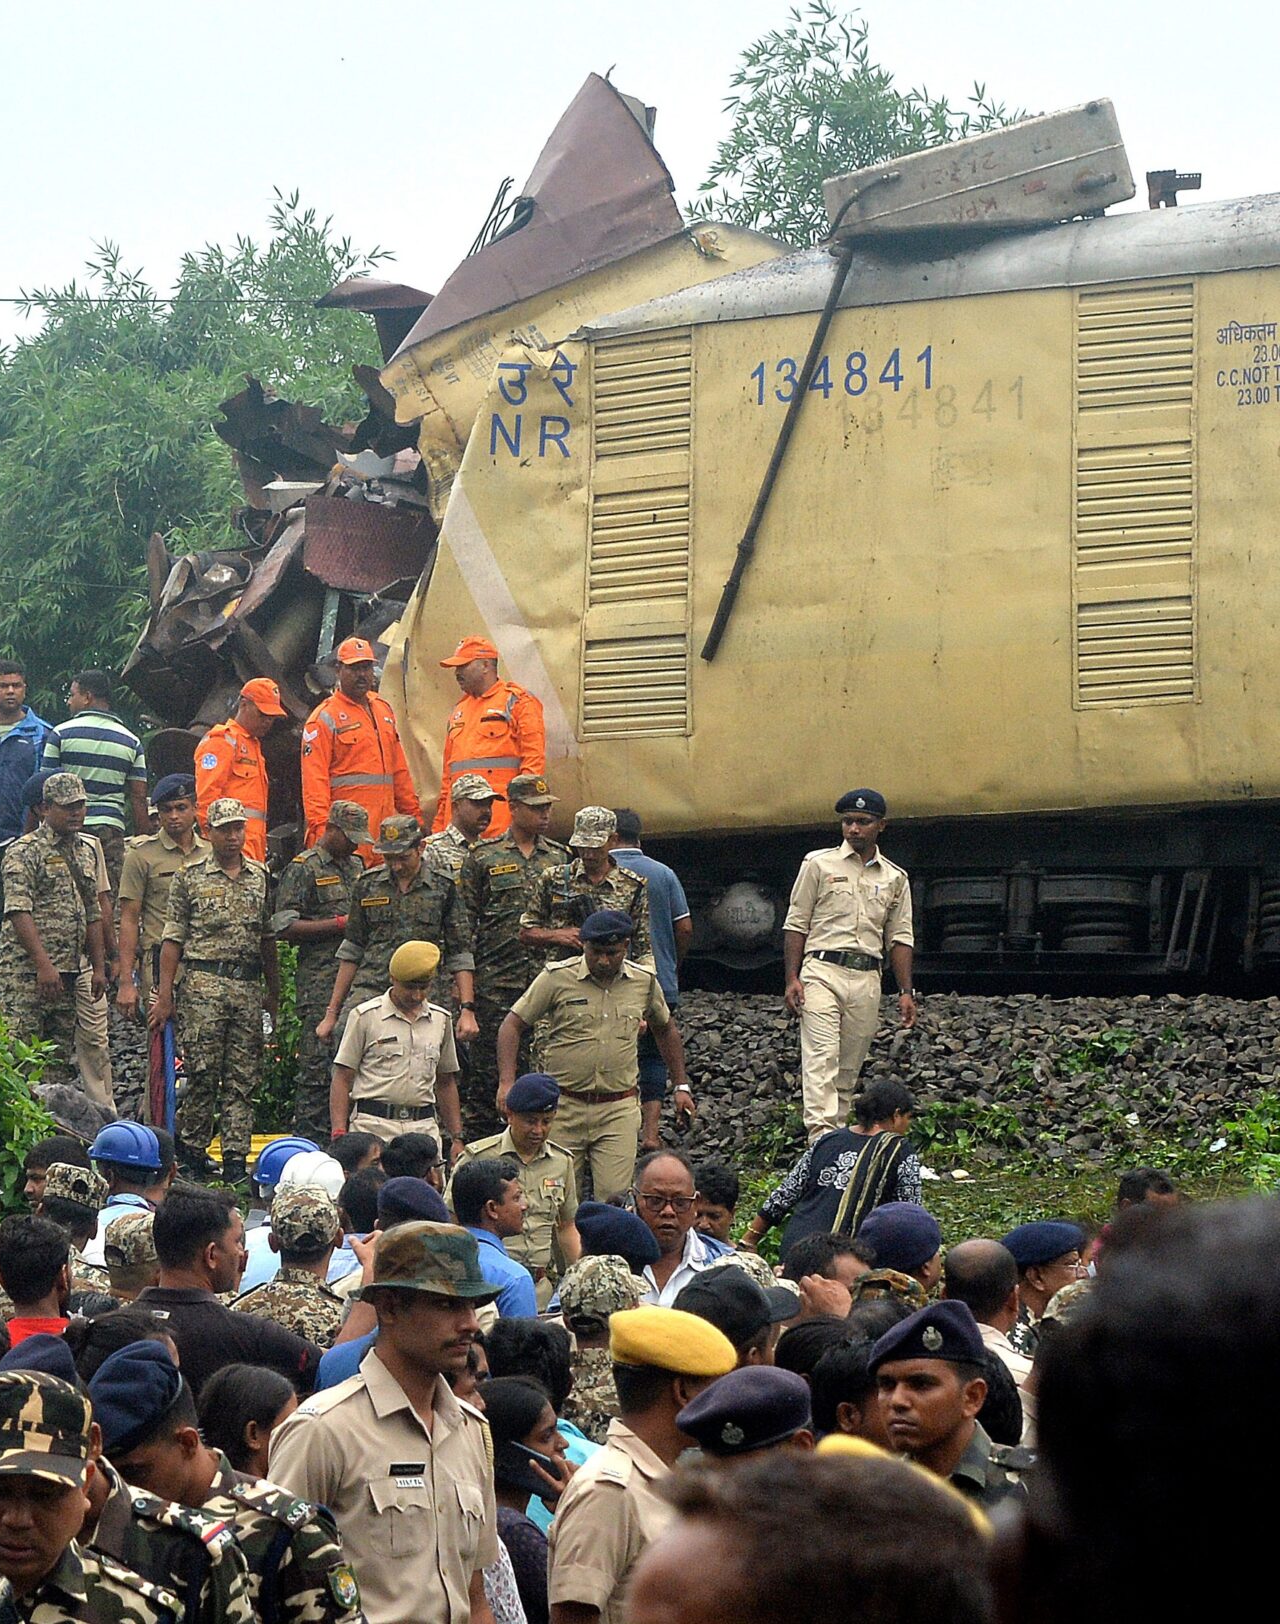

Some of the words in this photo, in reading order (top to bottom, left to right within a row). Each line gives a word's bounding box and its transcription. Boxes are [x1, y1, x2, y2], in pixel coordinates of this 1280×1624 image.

[1216, 320, 1277, 345] अधिकतम
[750, 345, 933, 406] 134841
[1237, 386, 1270, 406] 23.00
